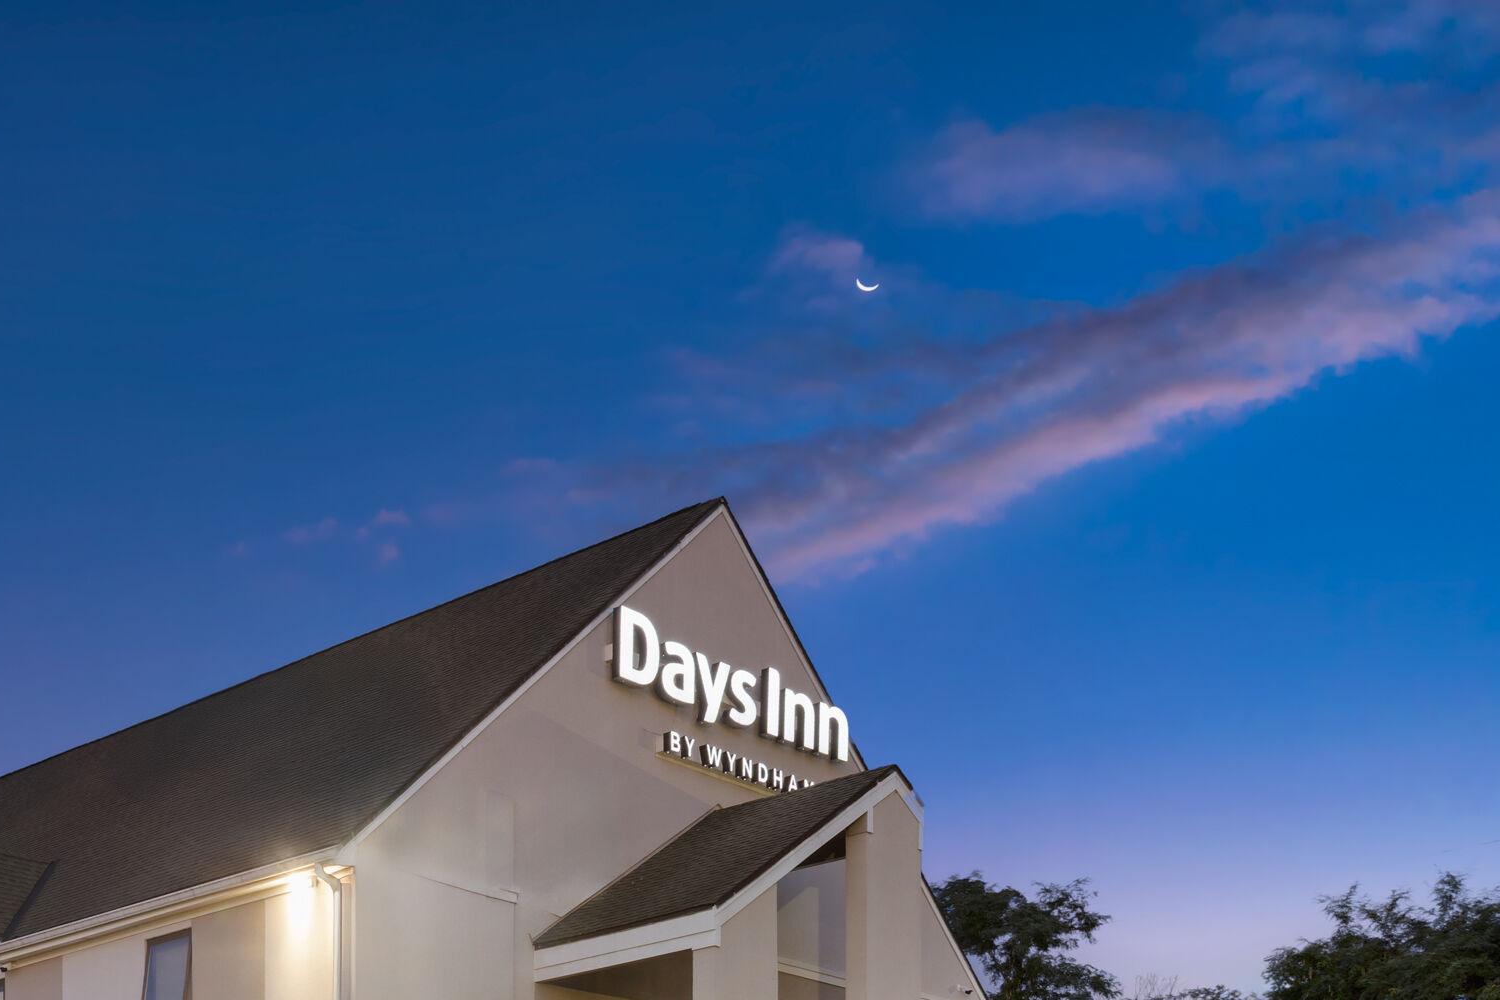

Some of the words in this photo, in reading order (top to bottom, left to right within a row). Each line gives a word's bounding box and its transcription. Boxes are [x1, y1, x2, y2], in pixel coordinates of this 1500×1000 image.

[617, 604, 758, 726] Days
[764, 666, 849, 762] Inn
[669, 730, 695, 757] BY
